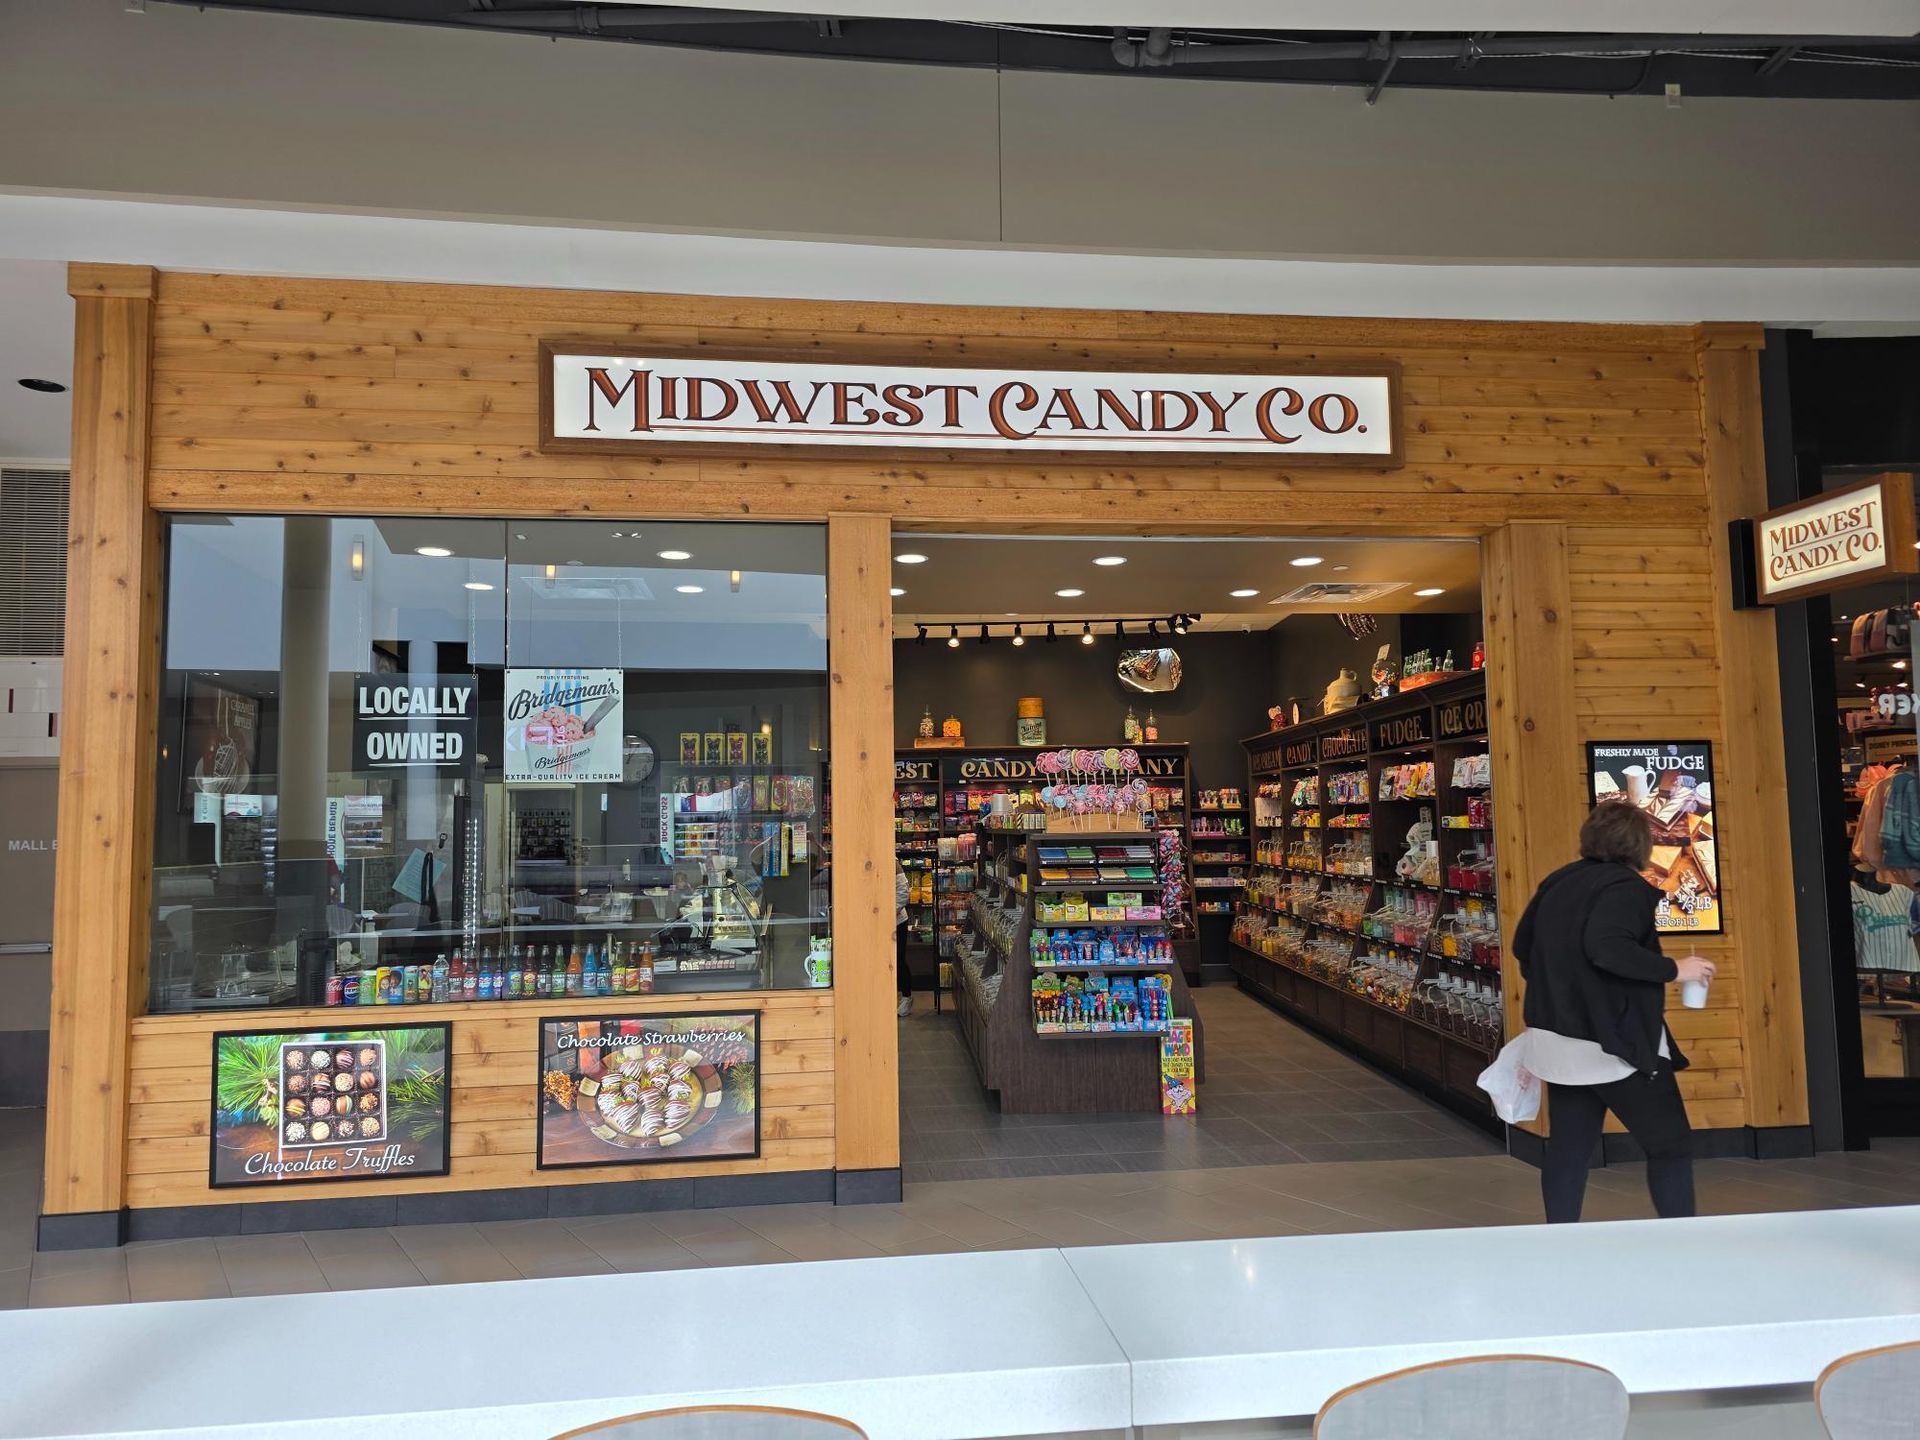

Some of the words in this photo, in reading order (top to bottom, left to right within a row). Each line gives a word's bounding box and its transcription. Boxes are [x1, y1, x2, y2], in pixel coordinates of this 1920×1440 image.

[583, 367, 978, 433] MIDWEST
[988, 381, 1248, 440] CANDY
[1256, 386, 1368, 444] CO.
[1769, 501, 1877, 556] MIDWEST
[1770, 541, 1843, 581] CANDY
[1846, 532, 1882, 561] CO.
[359, 686, 472, 714] LOCALLY
[508, 678, 620, 720] Bridgeman's
[1380, 716, 1422, 747] FUDGE
[1440, 706, 1463, 735] ICE
[1465, 701, 1488, 730] CR
[366, 732, 463, 760] OWNED
[1286, 741, 1313, 763] CANDY
[1594, 749, 1631, 757] FRESHLY
[1633, 748, 1659, 757] MADE
[592, 772, 620, 780] CREAM
[960, 760, 1038, 778] CANDY
[1645, 755, 1704, 771] FUDGE
[9, 839, 48, 850] MALL
[1695, 896, 1712, 909] LB
[557, 1032, 642, 1049] Chocolate
[643, 1029, 746, 1046] Strawberries
[245, 1149, 337, 1175] Chocolate
[342, 1144, 415, 1172] Truffles
